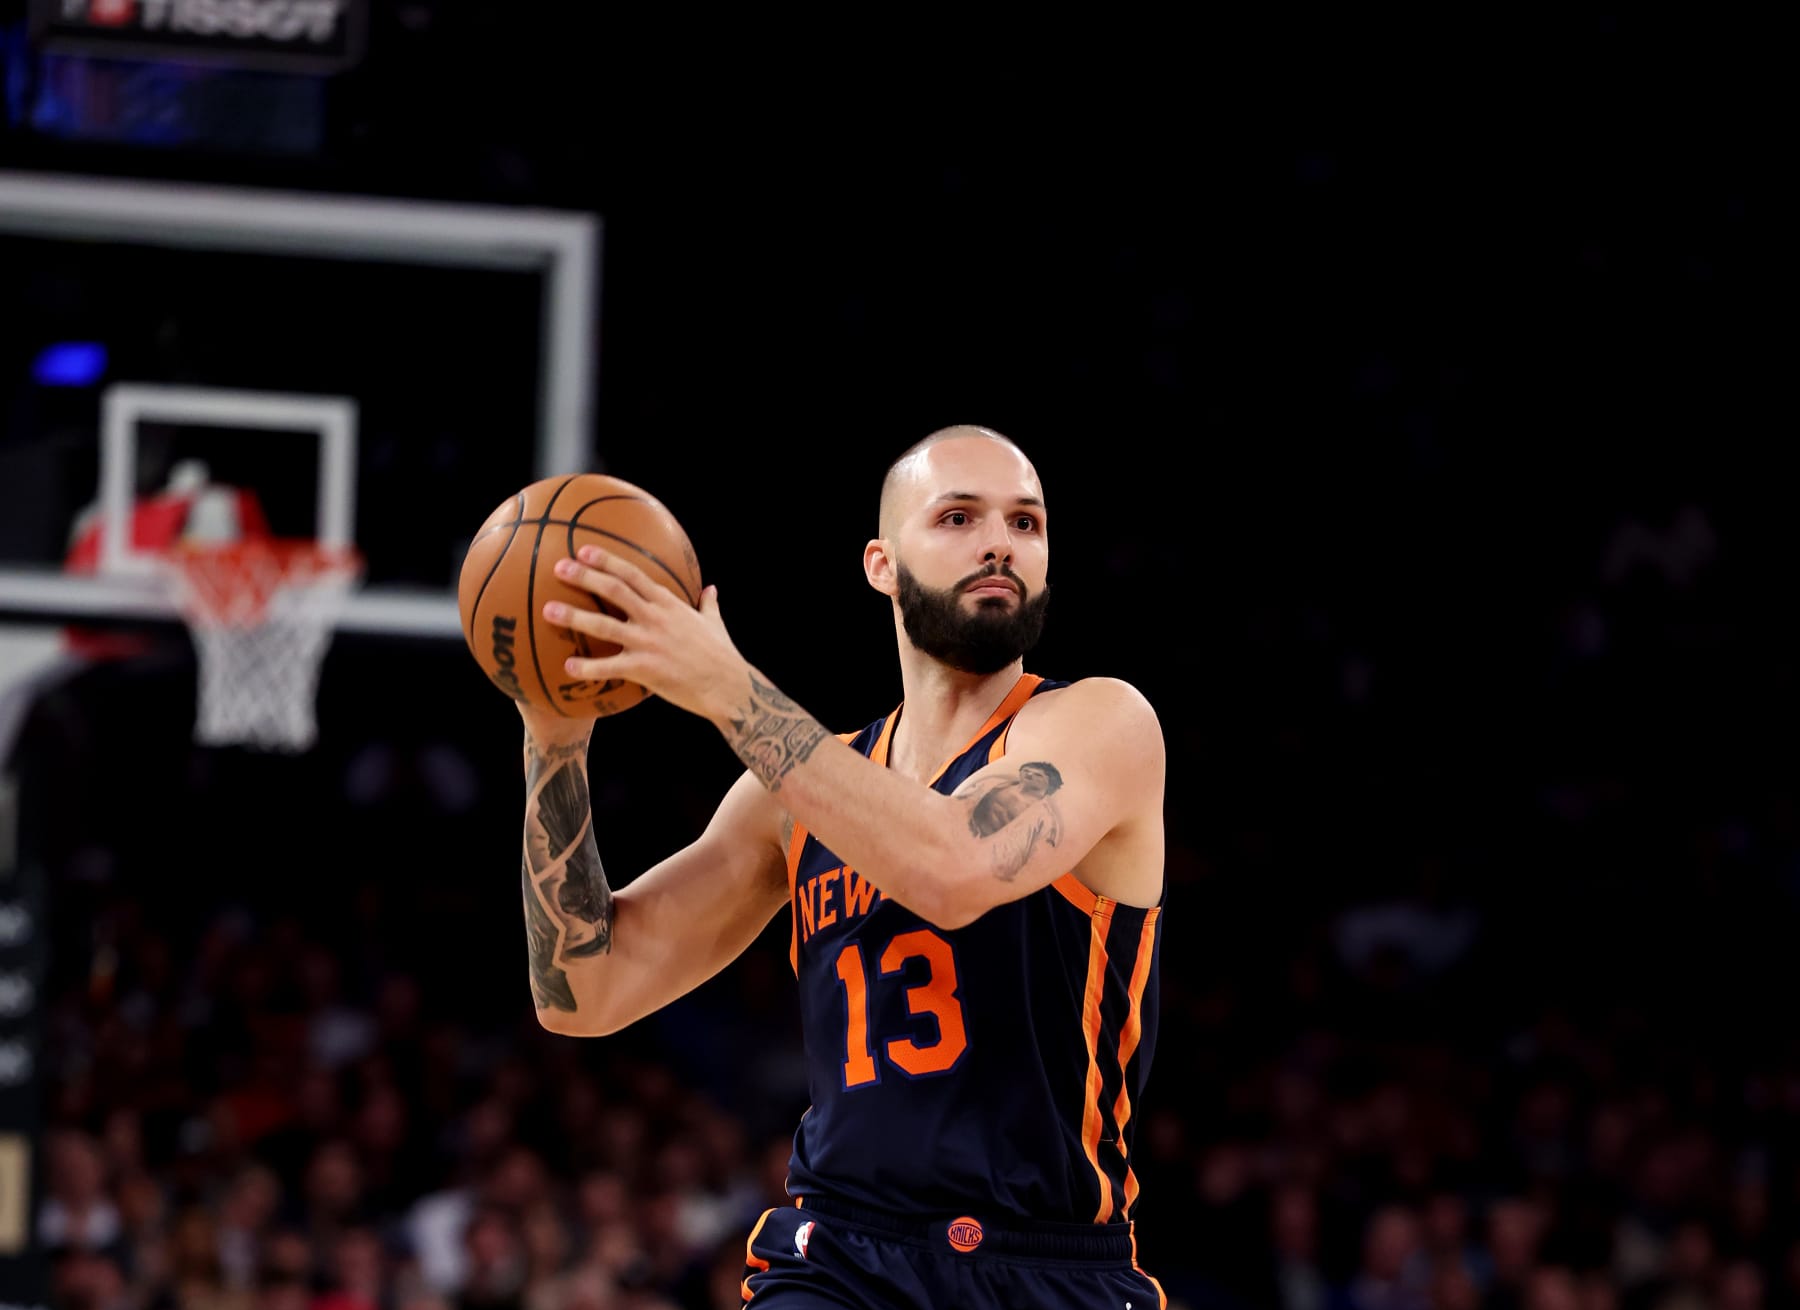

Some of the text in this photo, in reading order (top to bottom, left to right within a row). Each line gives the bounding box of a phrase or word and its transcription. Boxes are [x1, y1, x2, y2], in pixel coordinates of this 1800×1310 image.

[798, 865, 878, 945] NEW
[834, 927, 971, 1091] 13
[950, 1225, 981, 1244] KNICKS
